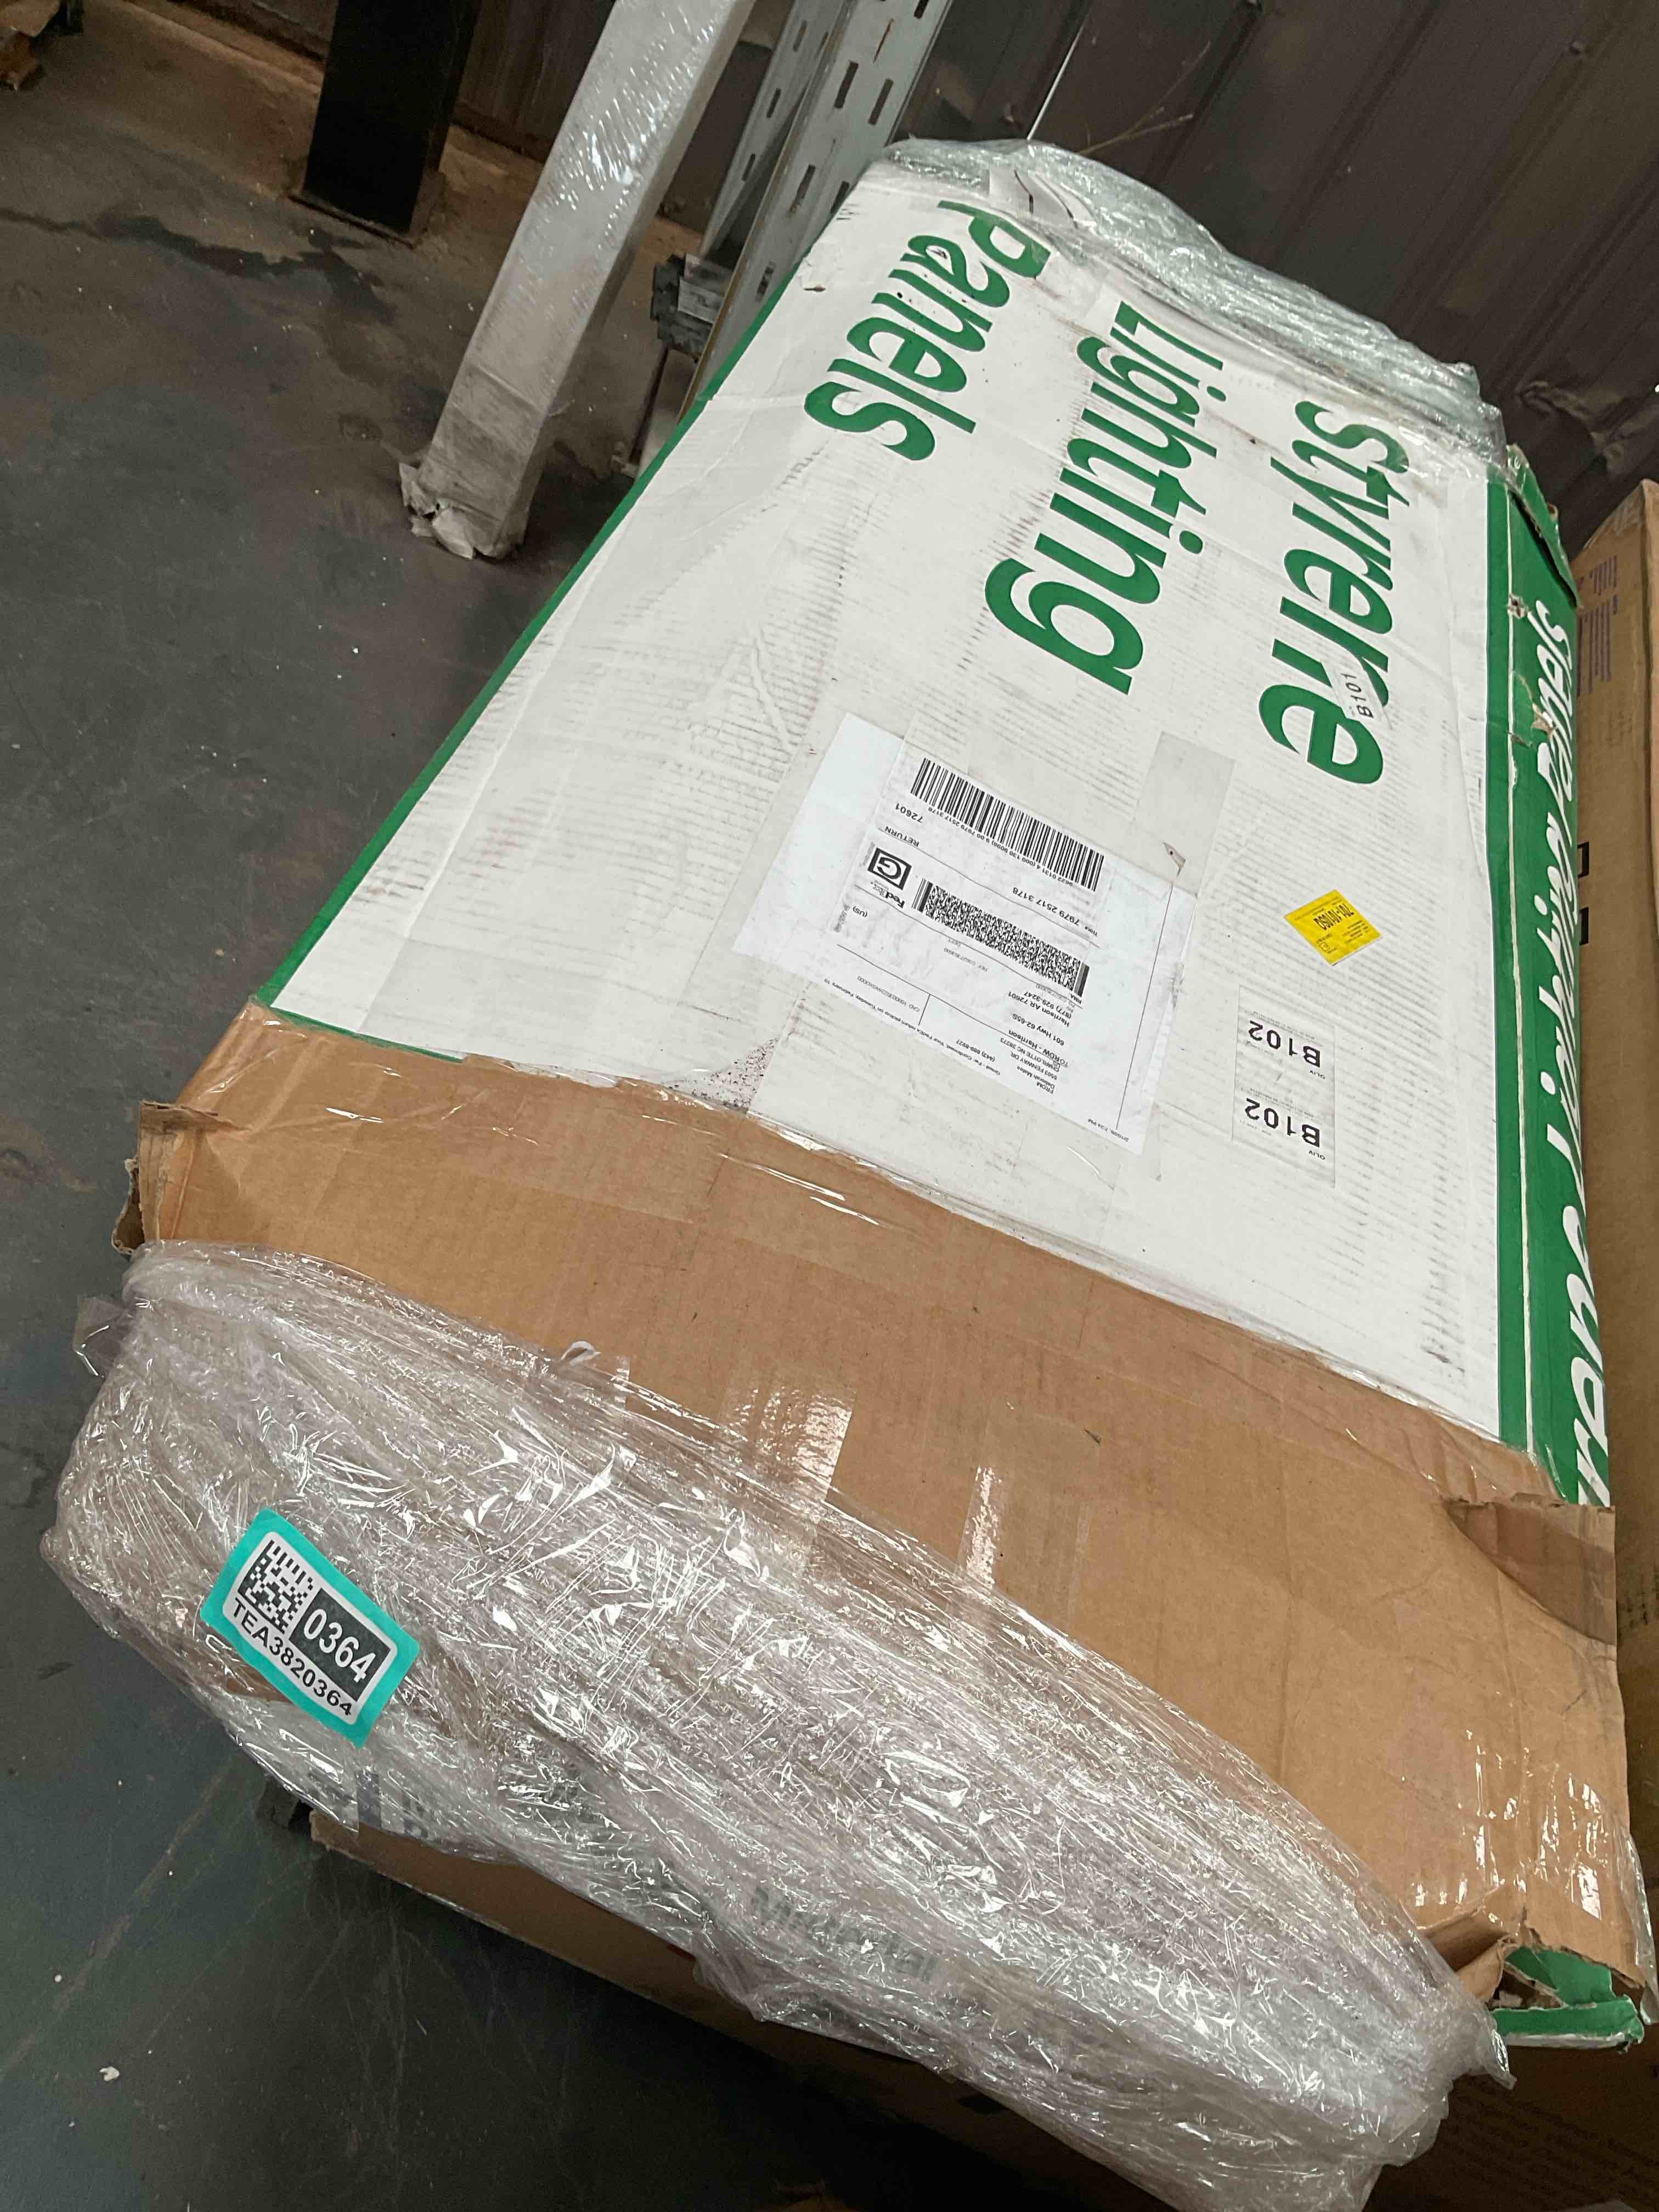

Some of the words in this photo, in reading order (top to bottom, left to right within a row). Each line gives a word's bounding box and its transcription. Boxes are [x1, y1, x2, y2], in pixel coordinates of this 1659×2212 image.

[804, 199, 1051, 461] Panels
[985, 301, 1227, 695] Lighting
[1259, 400, 1410, 785] Styrene
[1341, 673, 1373, 718] B101
[895, 803, 923, 823] 72601
[884, 826, 919, 847] RETURN
[877, 856, 902, 880] G
[1012, 887, 1034, 902] 3178
[853, 906, 868, 918] (US)
[1036, 899, 1058, 913] 2517
[1059, 910, 1080, 926] 7979
[1008, 991, 1028, 1005] 72601
[1030, 1001, 1040, 1010] AR
[1041, 1007, 1070, 1027] Harrison
[1056, 1005, 1072, 1019] (877)
[1008, 1030, 1037, 1049] Harrison
[1036, 1025, 1052, 1039] Hwy
[1053, 1036, 1064, 1046] 601
[1248, 1021, 1321, 1067] B102
[1019, 1057, 1044, 1073] FENWAY
[1026, 1051, 1059, 1073] CHARLOTTE
[1308, 1069, 1326, 1080] OLIV
[1245, 1098, 1321, 1148] B102
[1308, 1150, 1325, 1160] OLIV
[304, 1609, 376, 1683] 0364
[232, 1598, 353, 1716] TEA3820364
